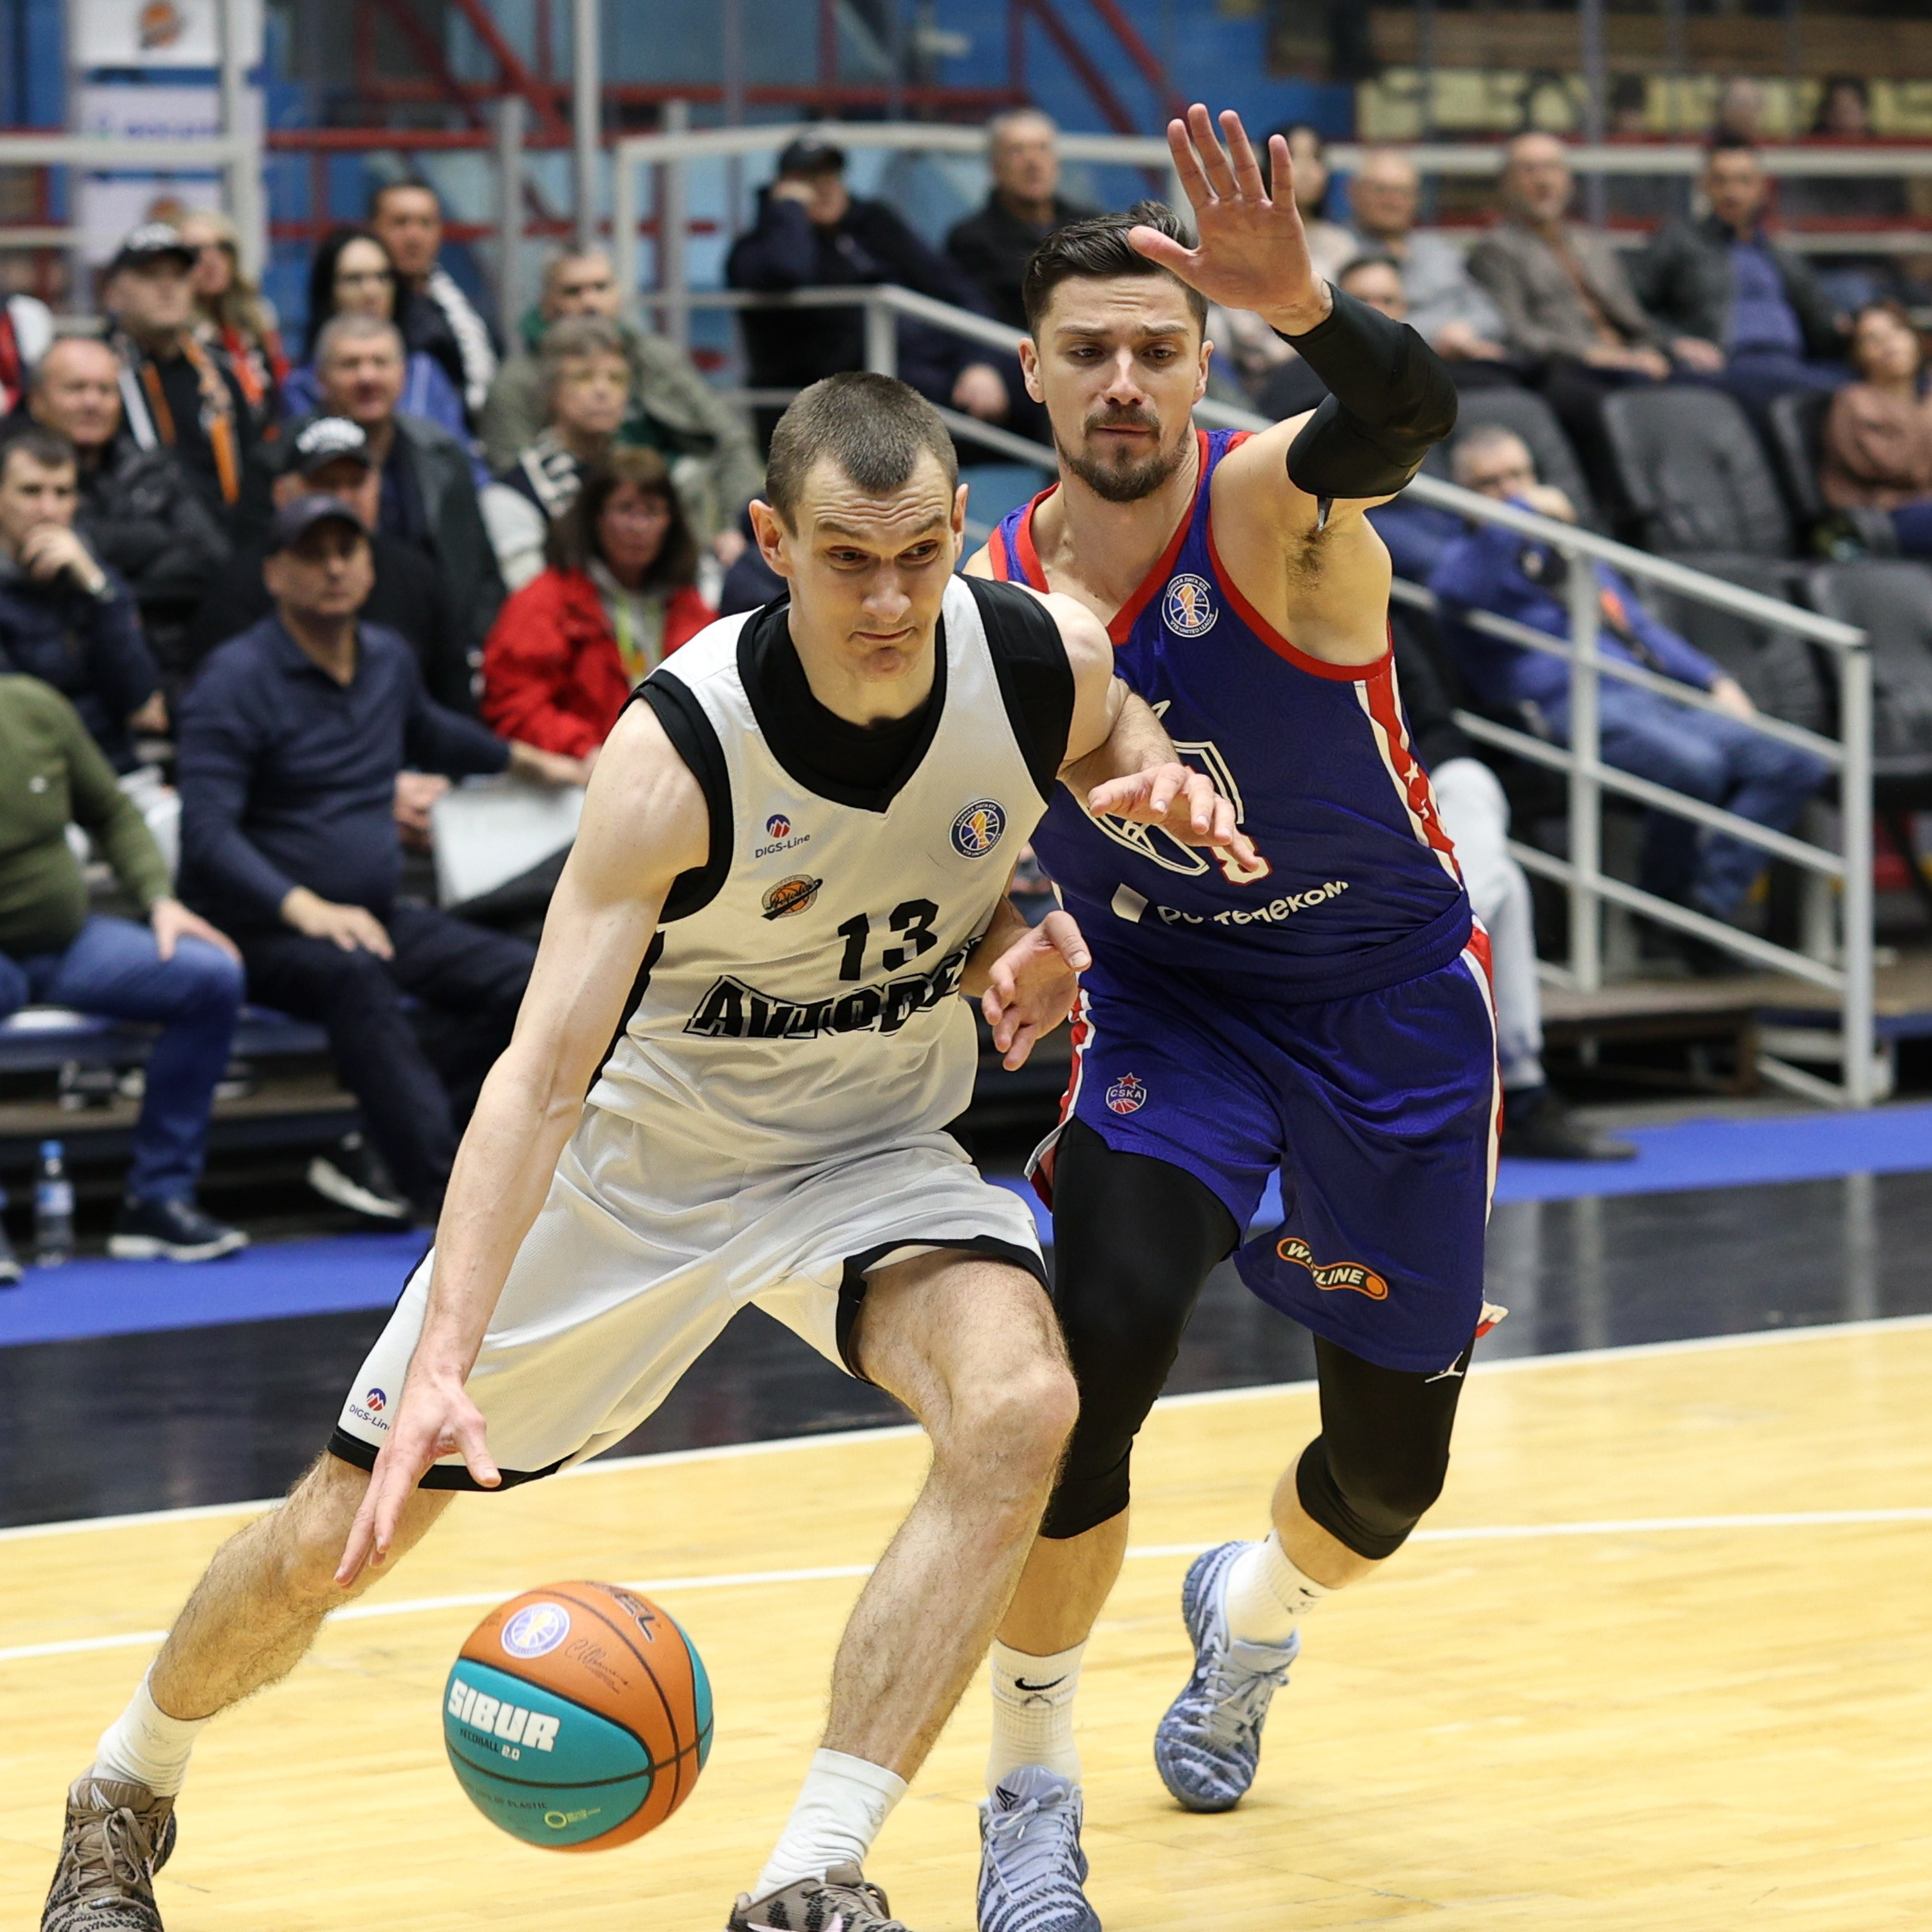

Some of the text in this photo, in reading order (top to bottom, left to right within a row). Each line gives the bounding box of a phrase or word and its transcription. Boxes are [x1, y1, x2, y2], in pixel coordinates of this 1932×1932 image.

[755, 834, 811, 859] DIGS-Line
[838, 897, 940, 981] 13
[1110, 1089, 1142, 1099] CSKA
[349, 1404, 391, 1431] DIGS-Lin
[448, 1678, 561, 1753] SIBUR
